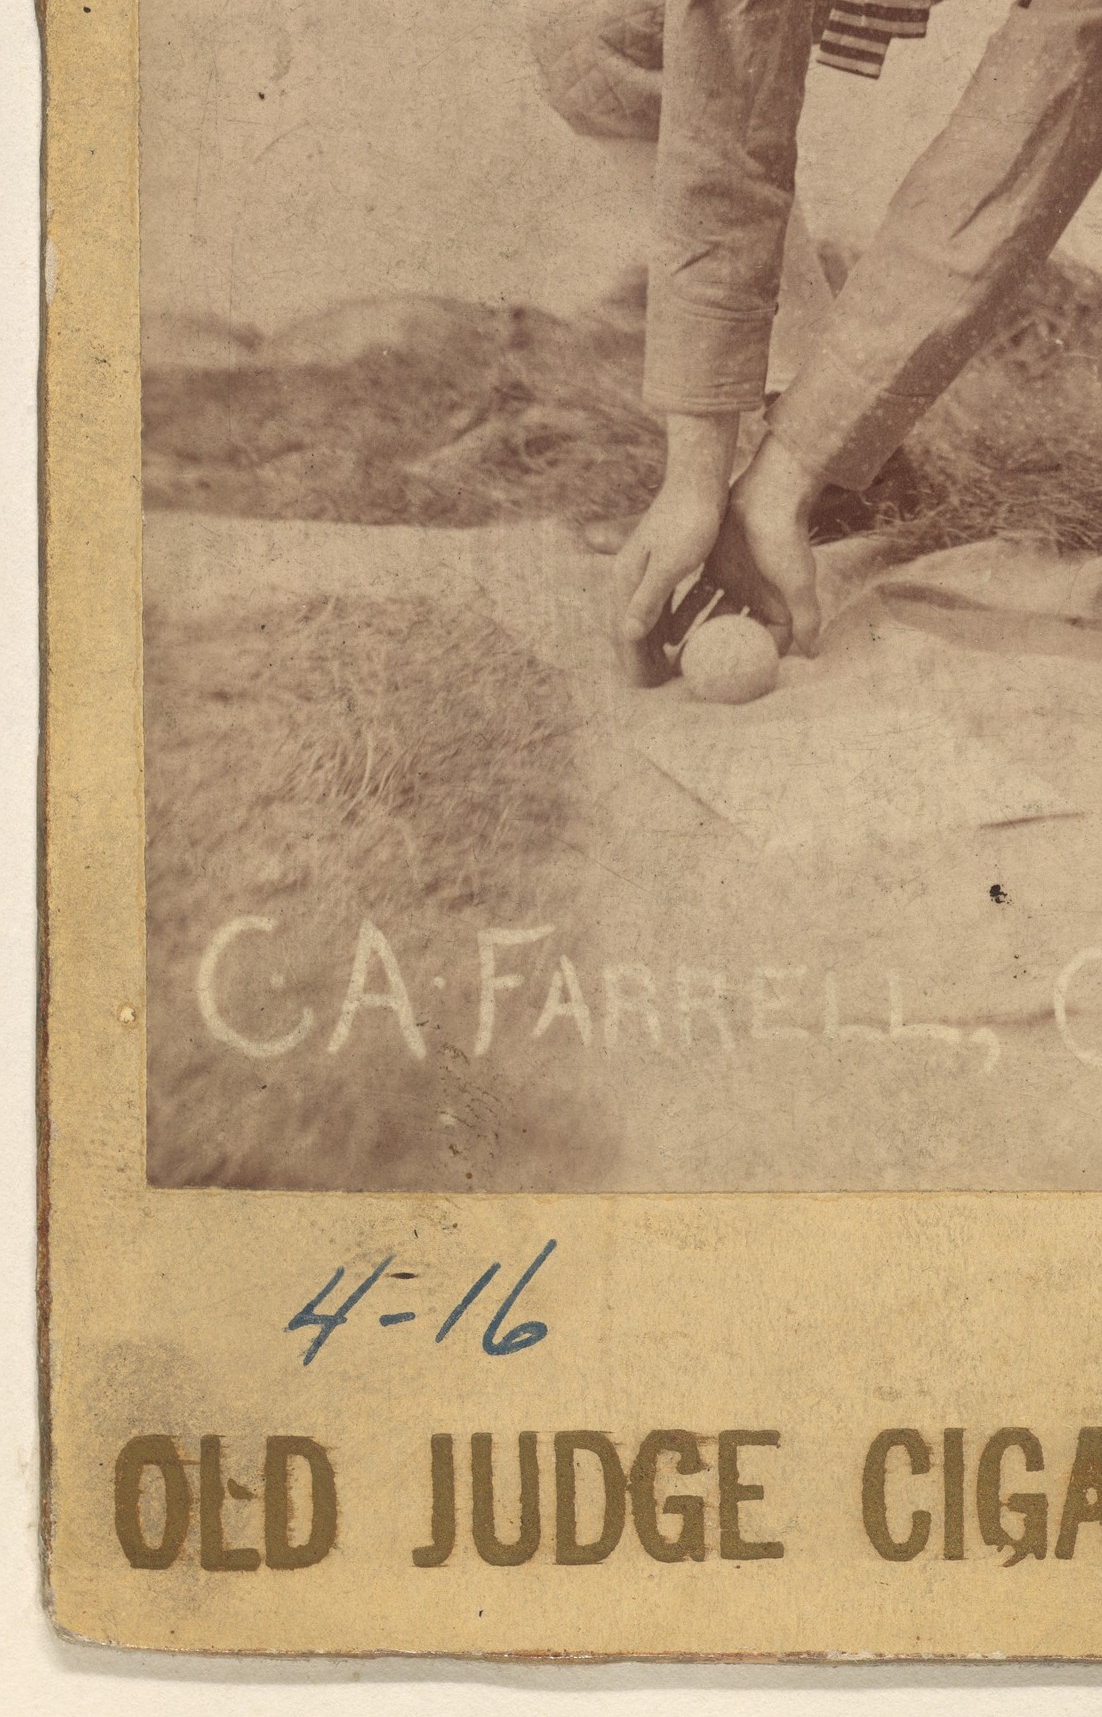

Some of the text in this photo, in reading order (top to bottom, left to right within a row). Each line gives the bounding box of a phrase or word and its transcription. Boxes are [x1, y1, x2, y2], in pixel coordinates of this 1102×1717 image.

[474, 924, 1000, 1074] FARRELL,
[284, 1238, 558, 1366] 4-16
[114, 1434, 339, 1570] OLD
[412, 1428, 785, 1568] JUDGE
